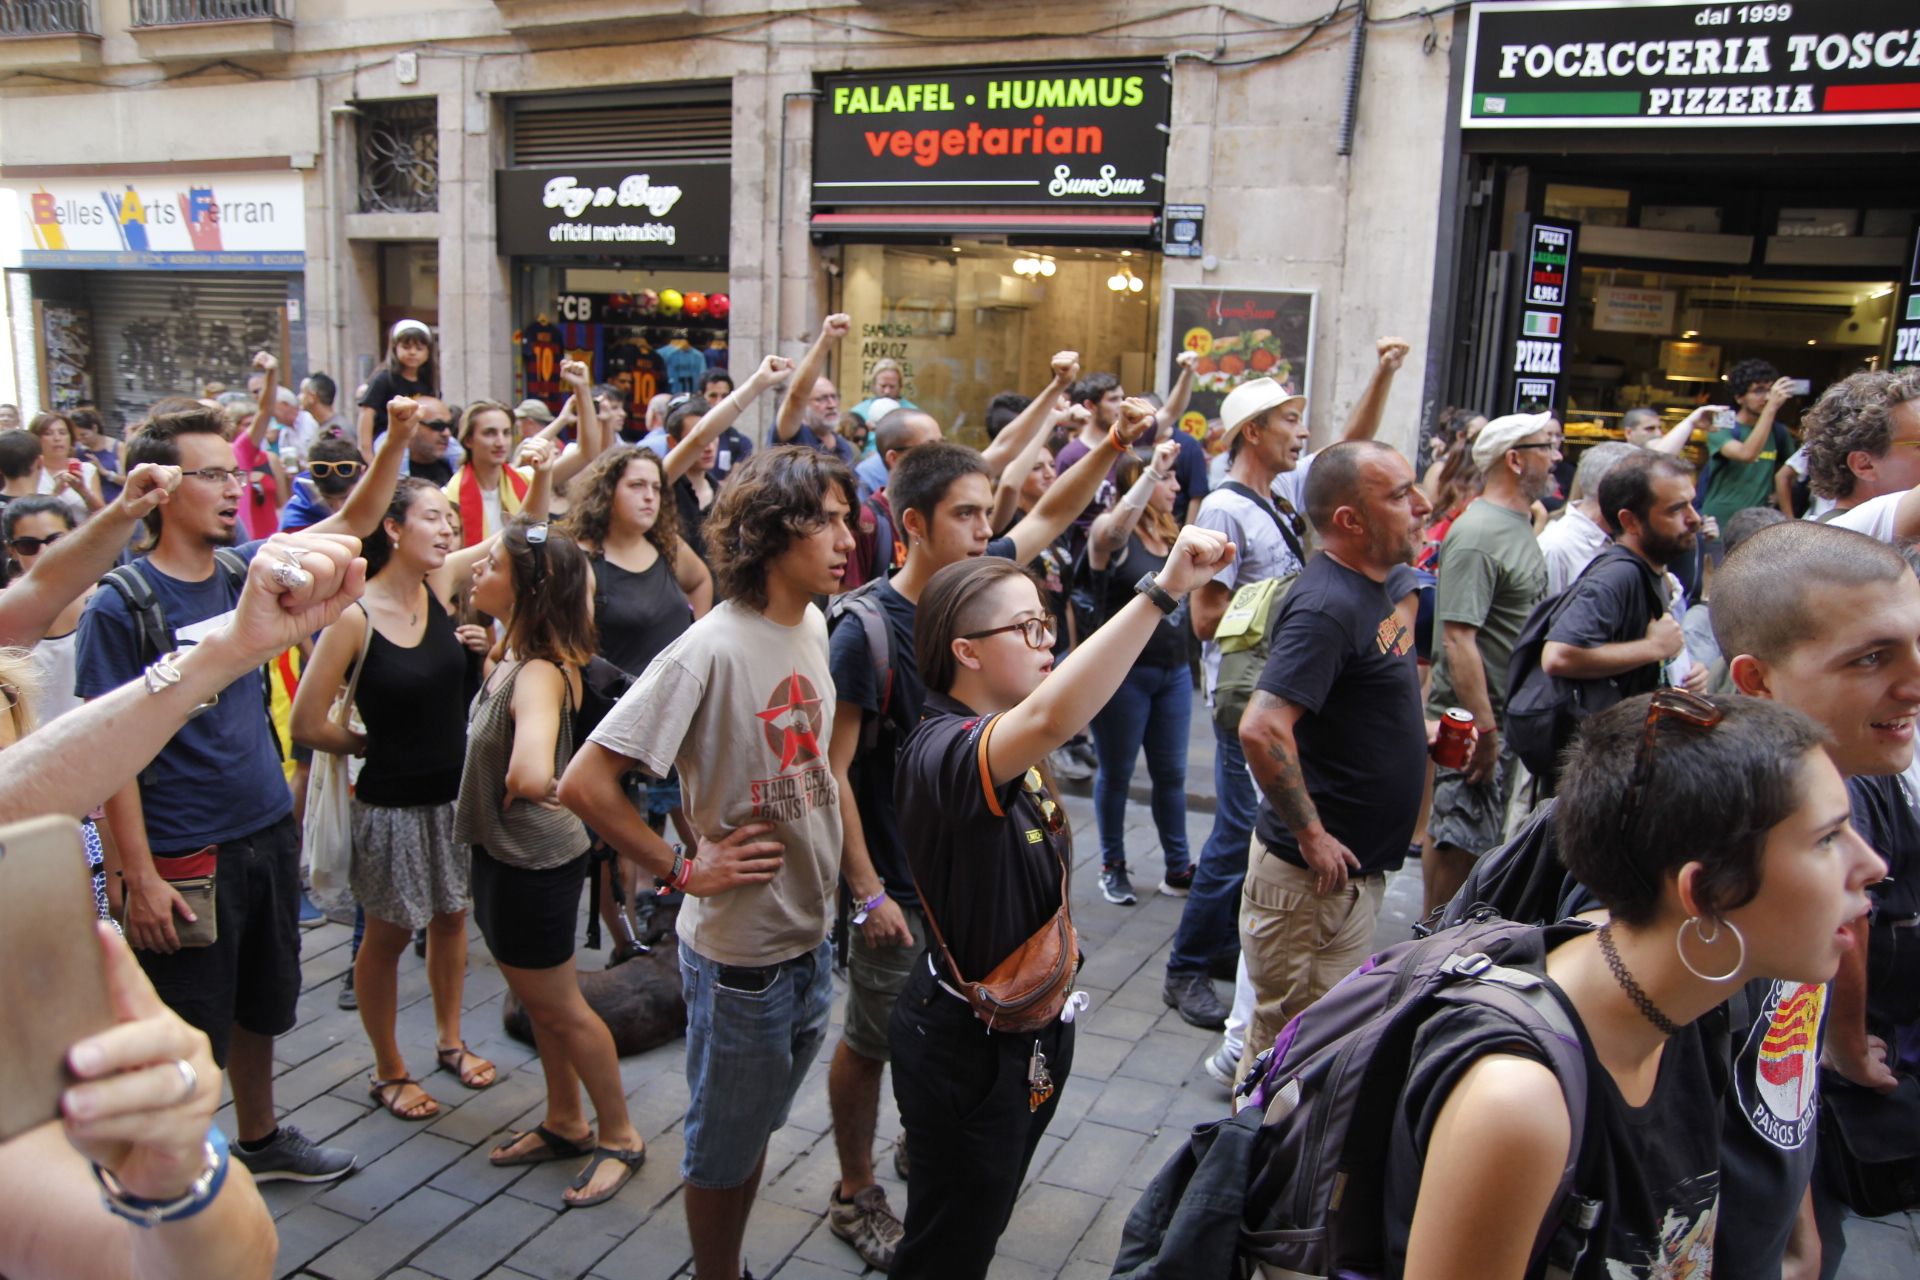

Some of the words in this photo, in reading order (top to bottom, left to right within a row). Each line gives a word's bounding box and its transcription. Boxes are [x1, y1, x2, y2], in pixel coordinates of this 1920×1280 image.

[1694, 7, 1730, 27] dal
[1736, 3, 1793, 24] 1999
[1498, 36, 1772, 79] FOCACCERIA
[834, 83, 955, 115] FALAFEL
[987, 76, 1144, 110] HUMMUS
[1646, 84, 1815, 115] PIZZERIA
[864, 114, 1104, 168] vegetarian
[1047, 164, 1146, 198] SumSum
[30, 192, 104, 226] Belles
[119, 186, 177, 225] Arts
[188, 186, 275, 224] Ferran
[549, 222, 593, 242] official
[592, 222, 676, 246] merchandising
[862, 341, 908, 359] ARROZ
[1513, 339, 1562, 374] PIZZA
[752, 778, 796, 804] STAND
